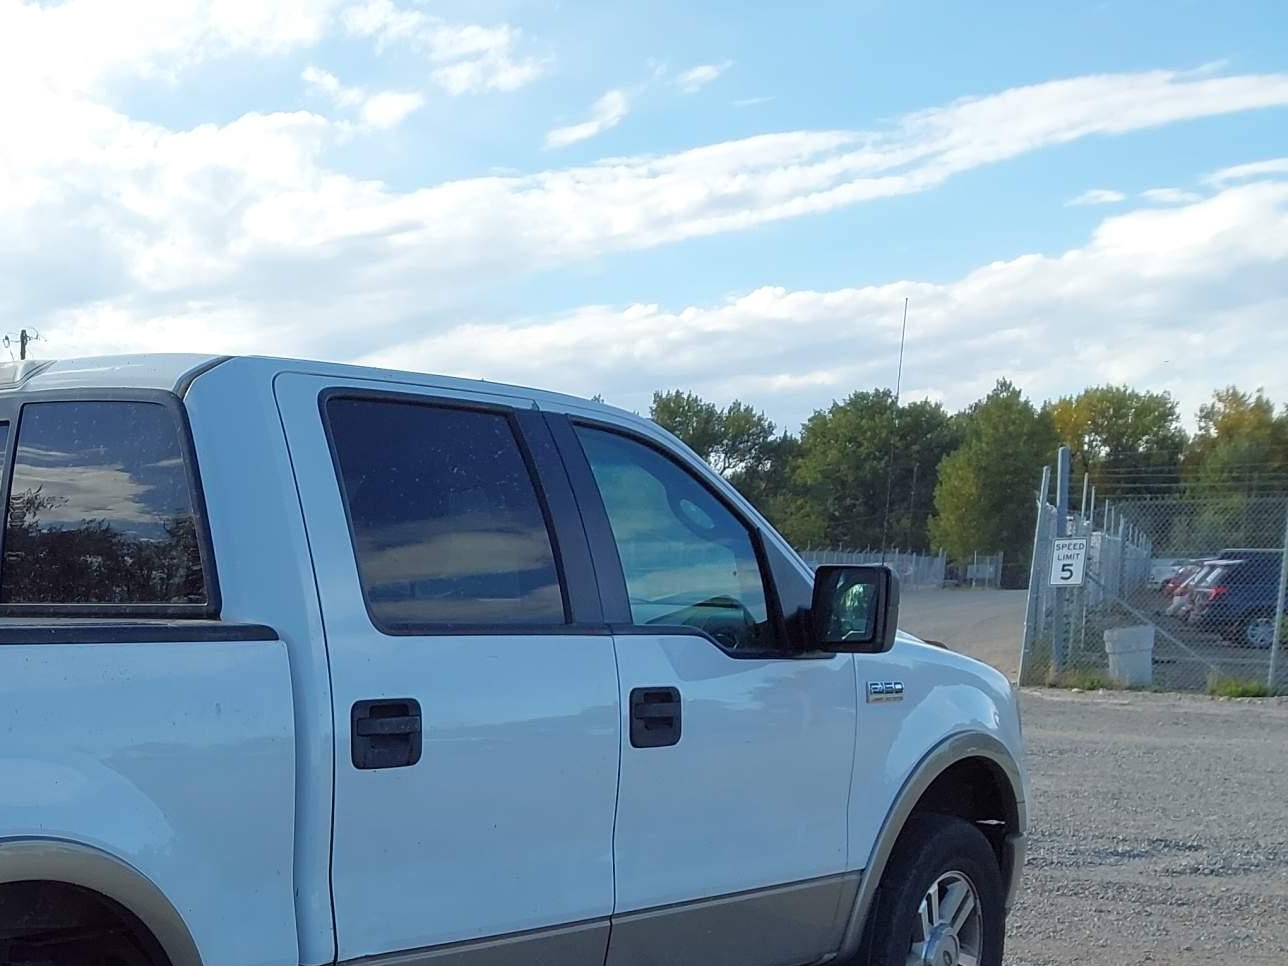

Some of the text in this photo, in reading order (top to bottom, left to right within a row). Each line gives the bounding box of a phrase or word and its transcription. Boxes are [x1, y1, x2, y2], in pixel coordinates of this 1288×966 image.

[1055, 543, 1085, 551] SPEED
[1057, 553, 1080, 561] LIMIT
[1060, 563, 1074, 581] 5
